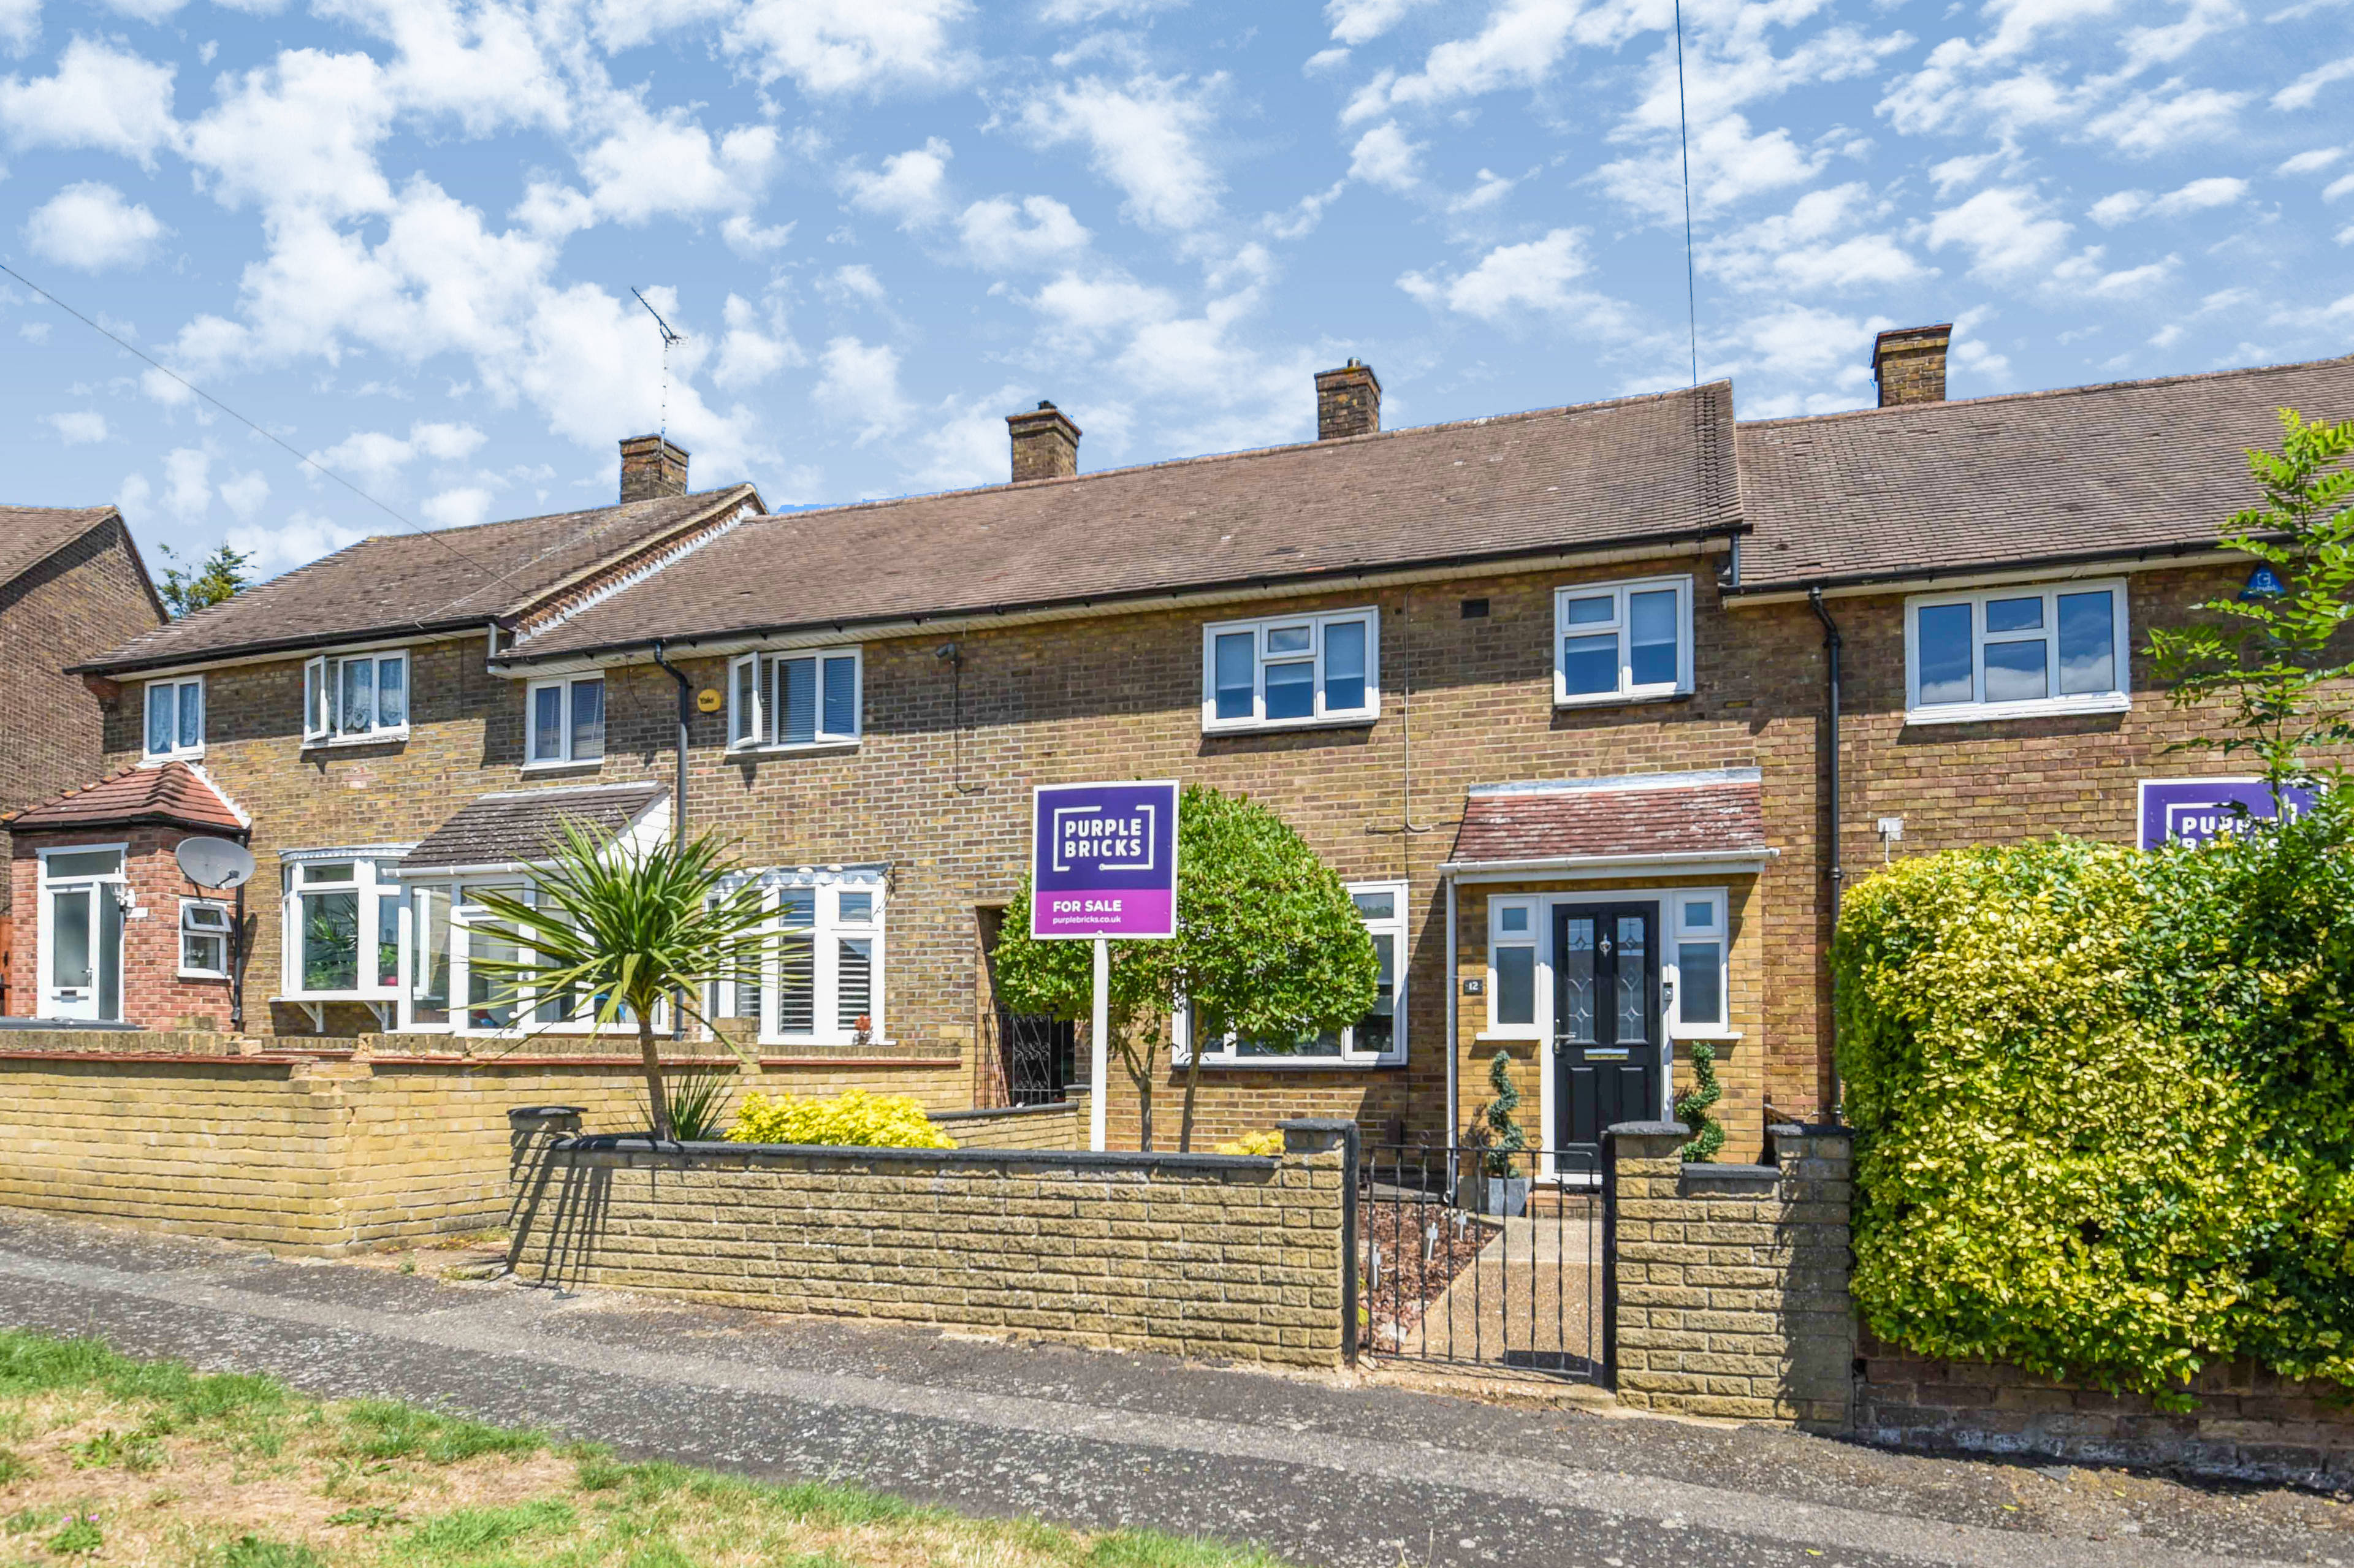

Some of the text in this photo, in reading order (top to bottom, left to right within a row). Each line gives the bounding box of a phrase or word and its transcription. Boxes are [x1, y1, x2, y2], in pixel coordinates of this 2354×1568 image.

[1065, 818, 1141, 838] PURPLE
[1065, 839, 1141, 858] BRICKS
[1053, 900, 1122, 912] FOR SALE
[1053, 915, 1121, 924] purplebricks.co.uk
[1469, 981, 1479, 991] 12
